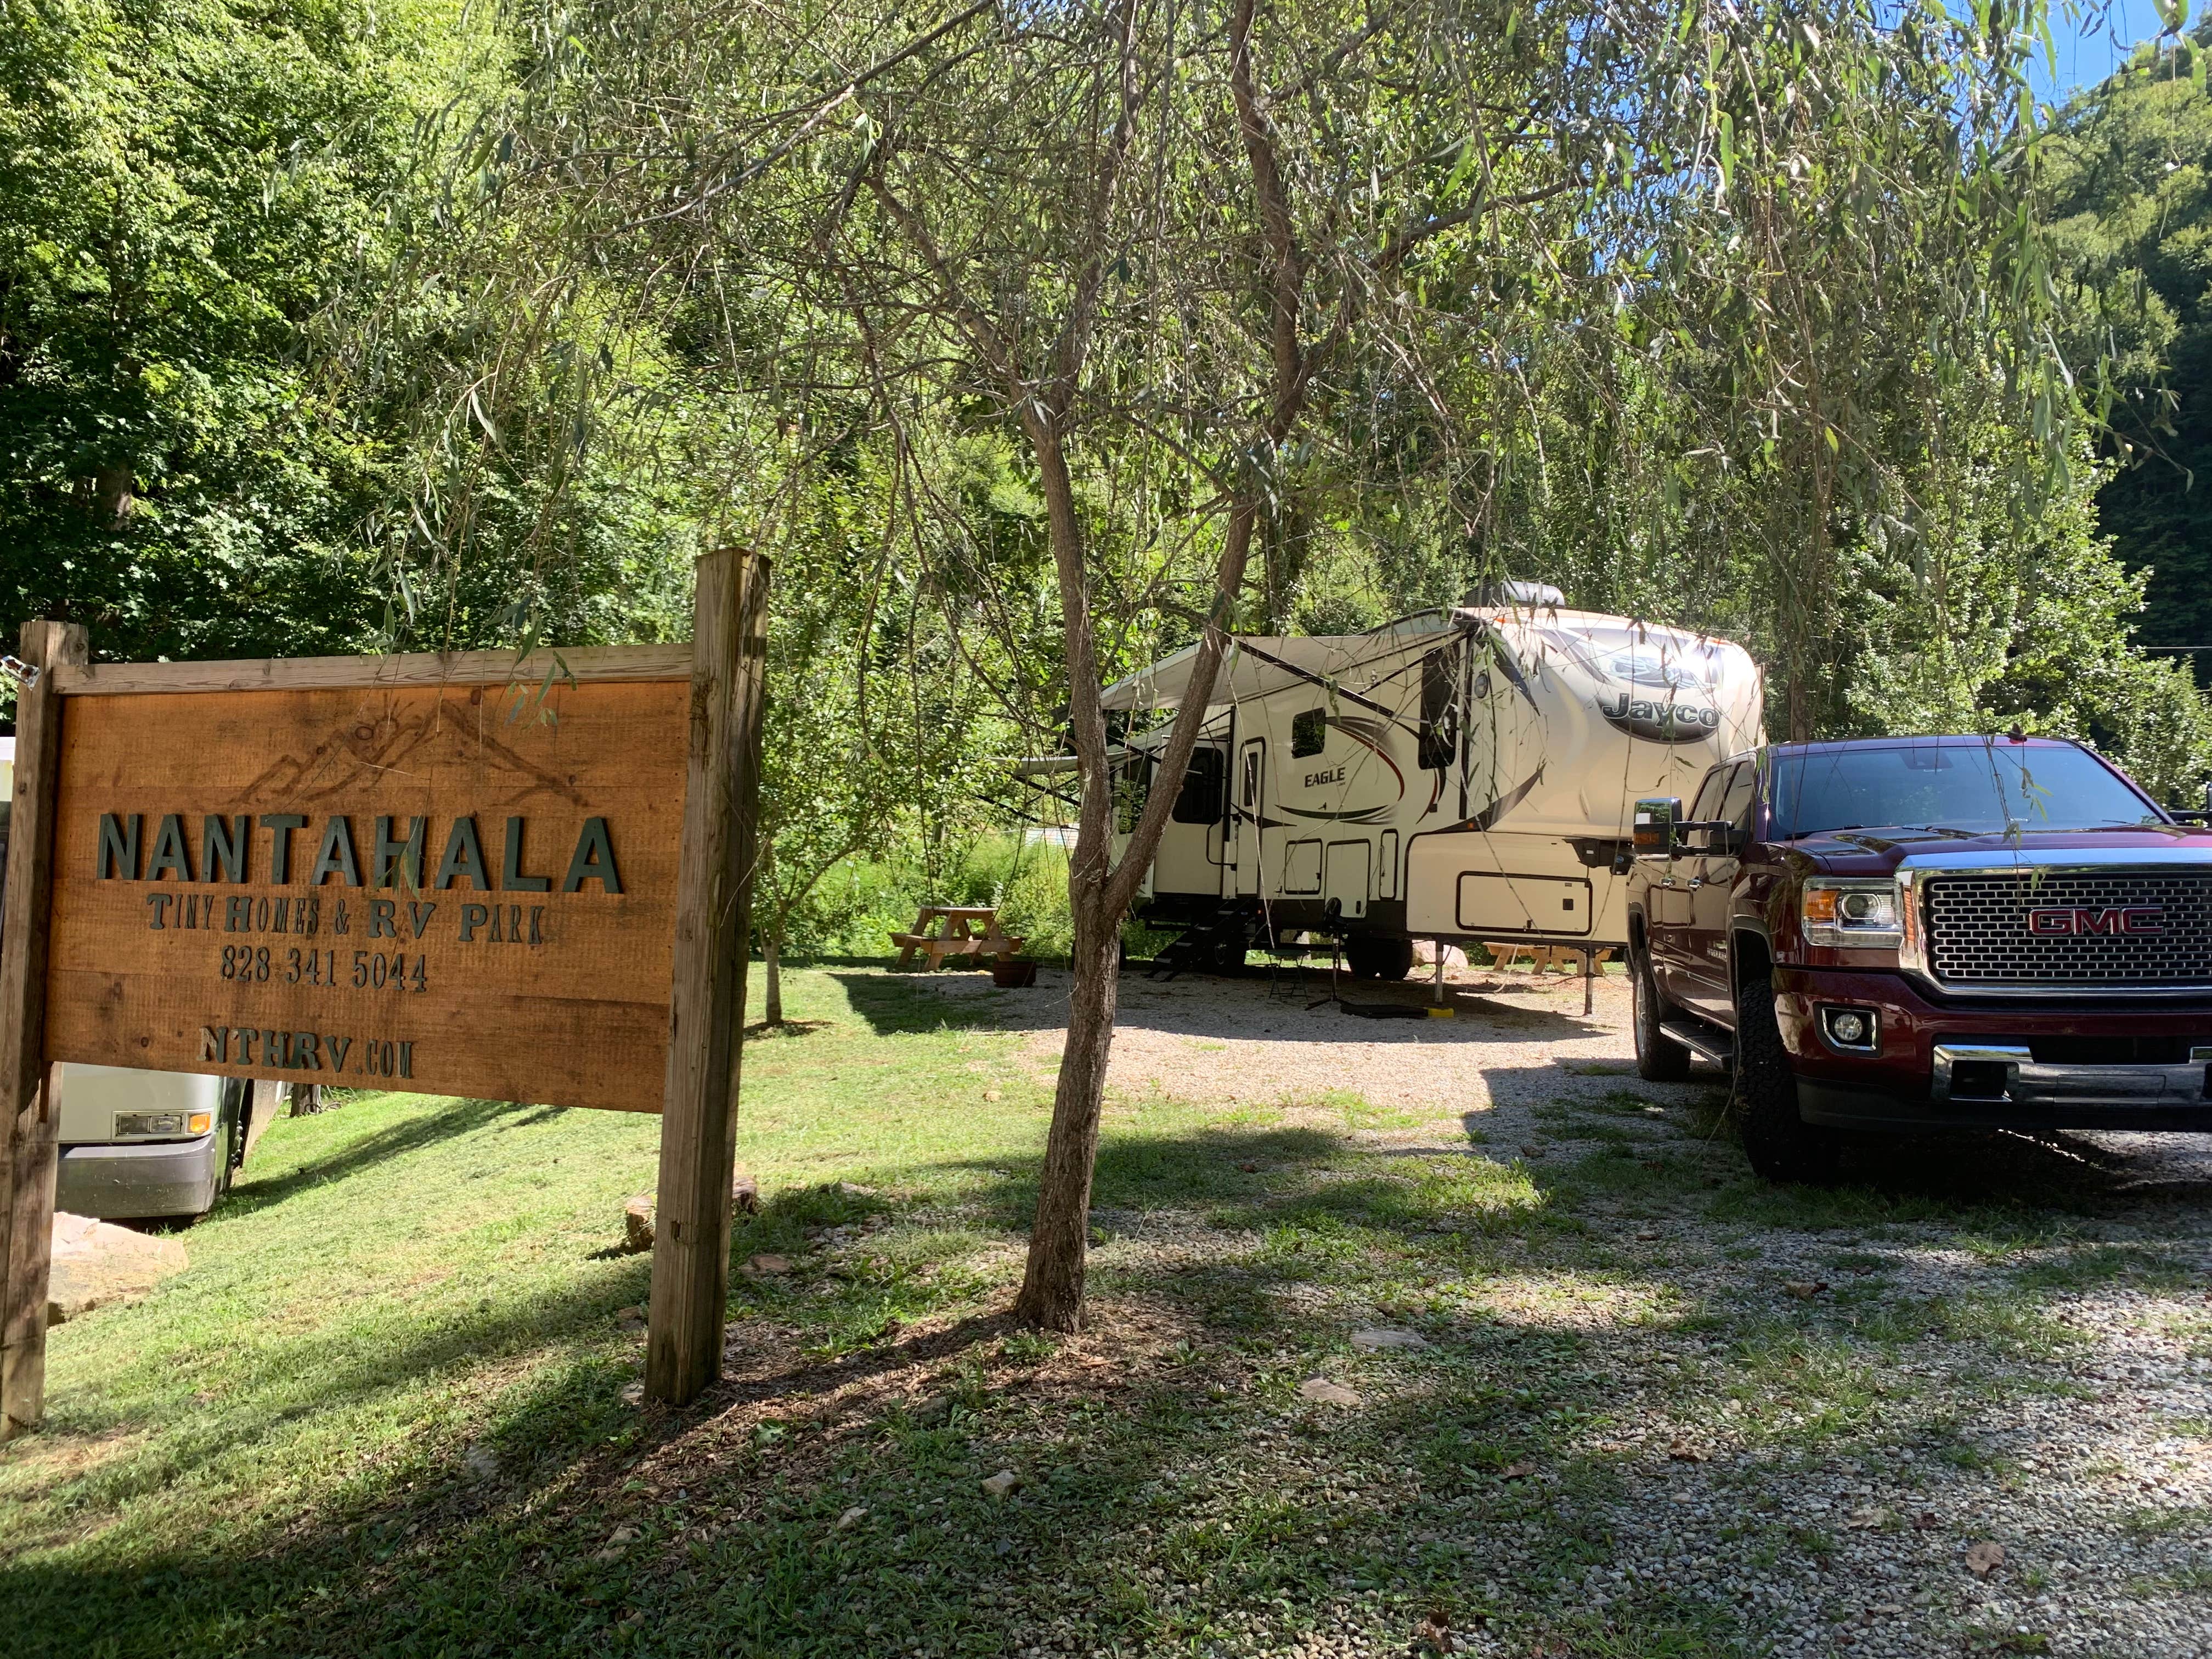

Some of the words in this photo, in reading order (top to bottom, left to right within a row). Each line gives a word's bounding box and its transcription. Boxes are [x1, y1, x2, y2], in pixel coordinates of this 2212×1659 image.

[1601, 693, 1721, 728] Jayco
[1304, 766, 1346, 788] EAGLE
[97, 813, 624, 894] NANTAHALA
[146, 893, 215, 930] TINY
[224, 896, 320, 935] HOMES
[333, 899, 349, 935] &
[368, 899, 436, 939] RV
[459, 903, 544, 945] PARK
[2029, 907, 2164, 936] GMC
[221, 945, 270, 983] 828
[286, 948, 336, 987] 341
[352, 950, 427, 992] 5044
